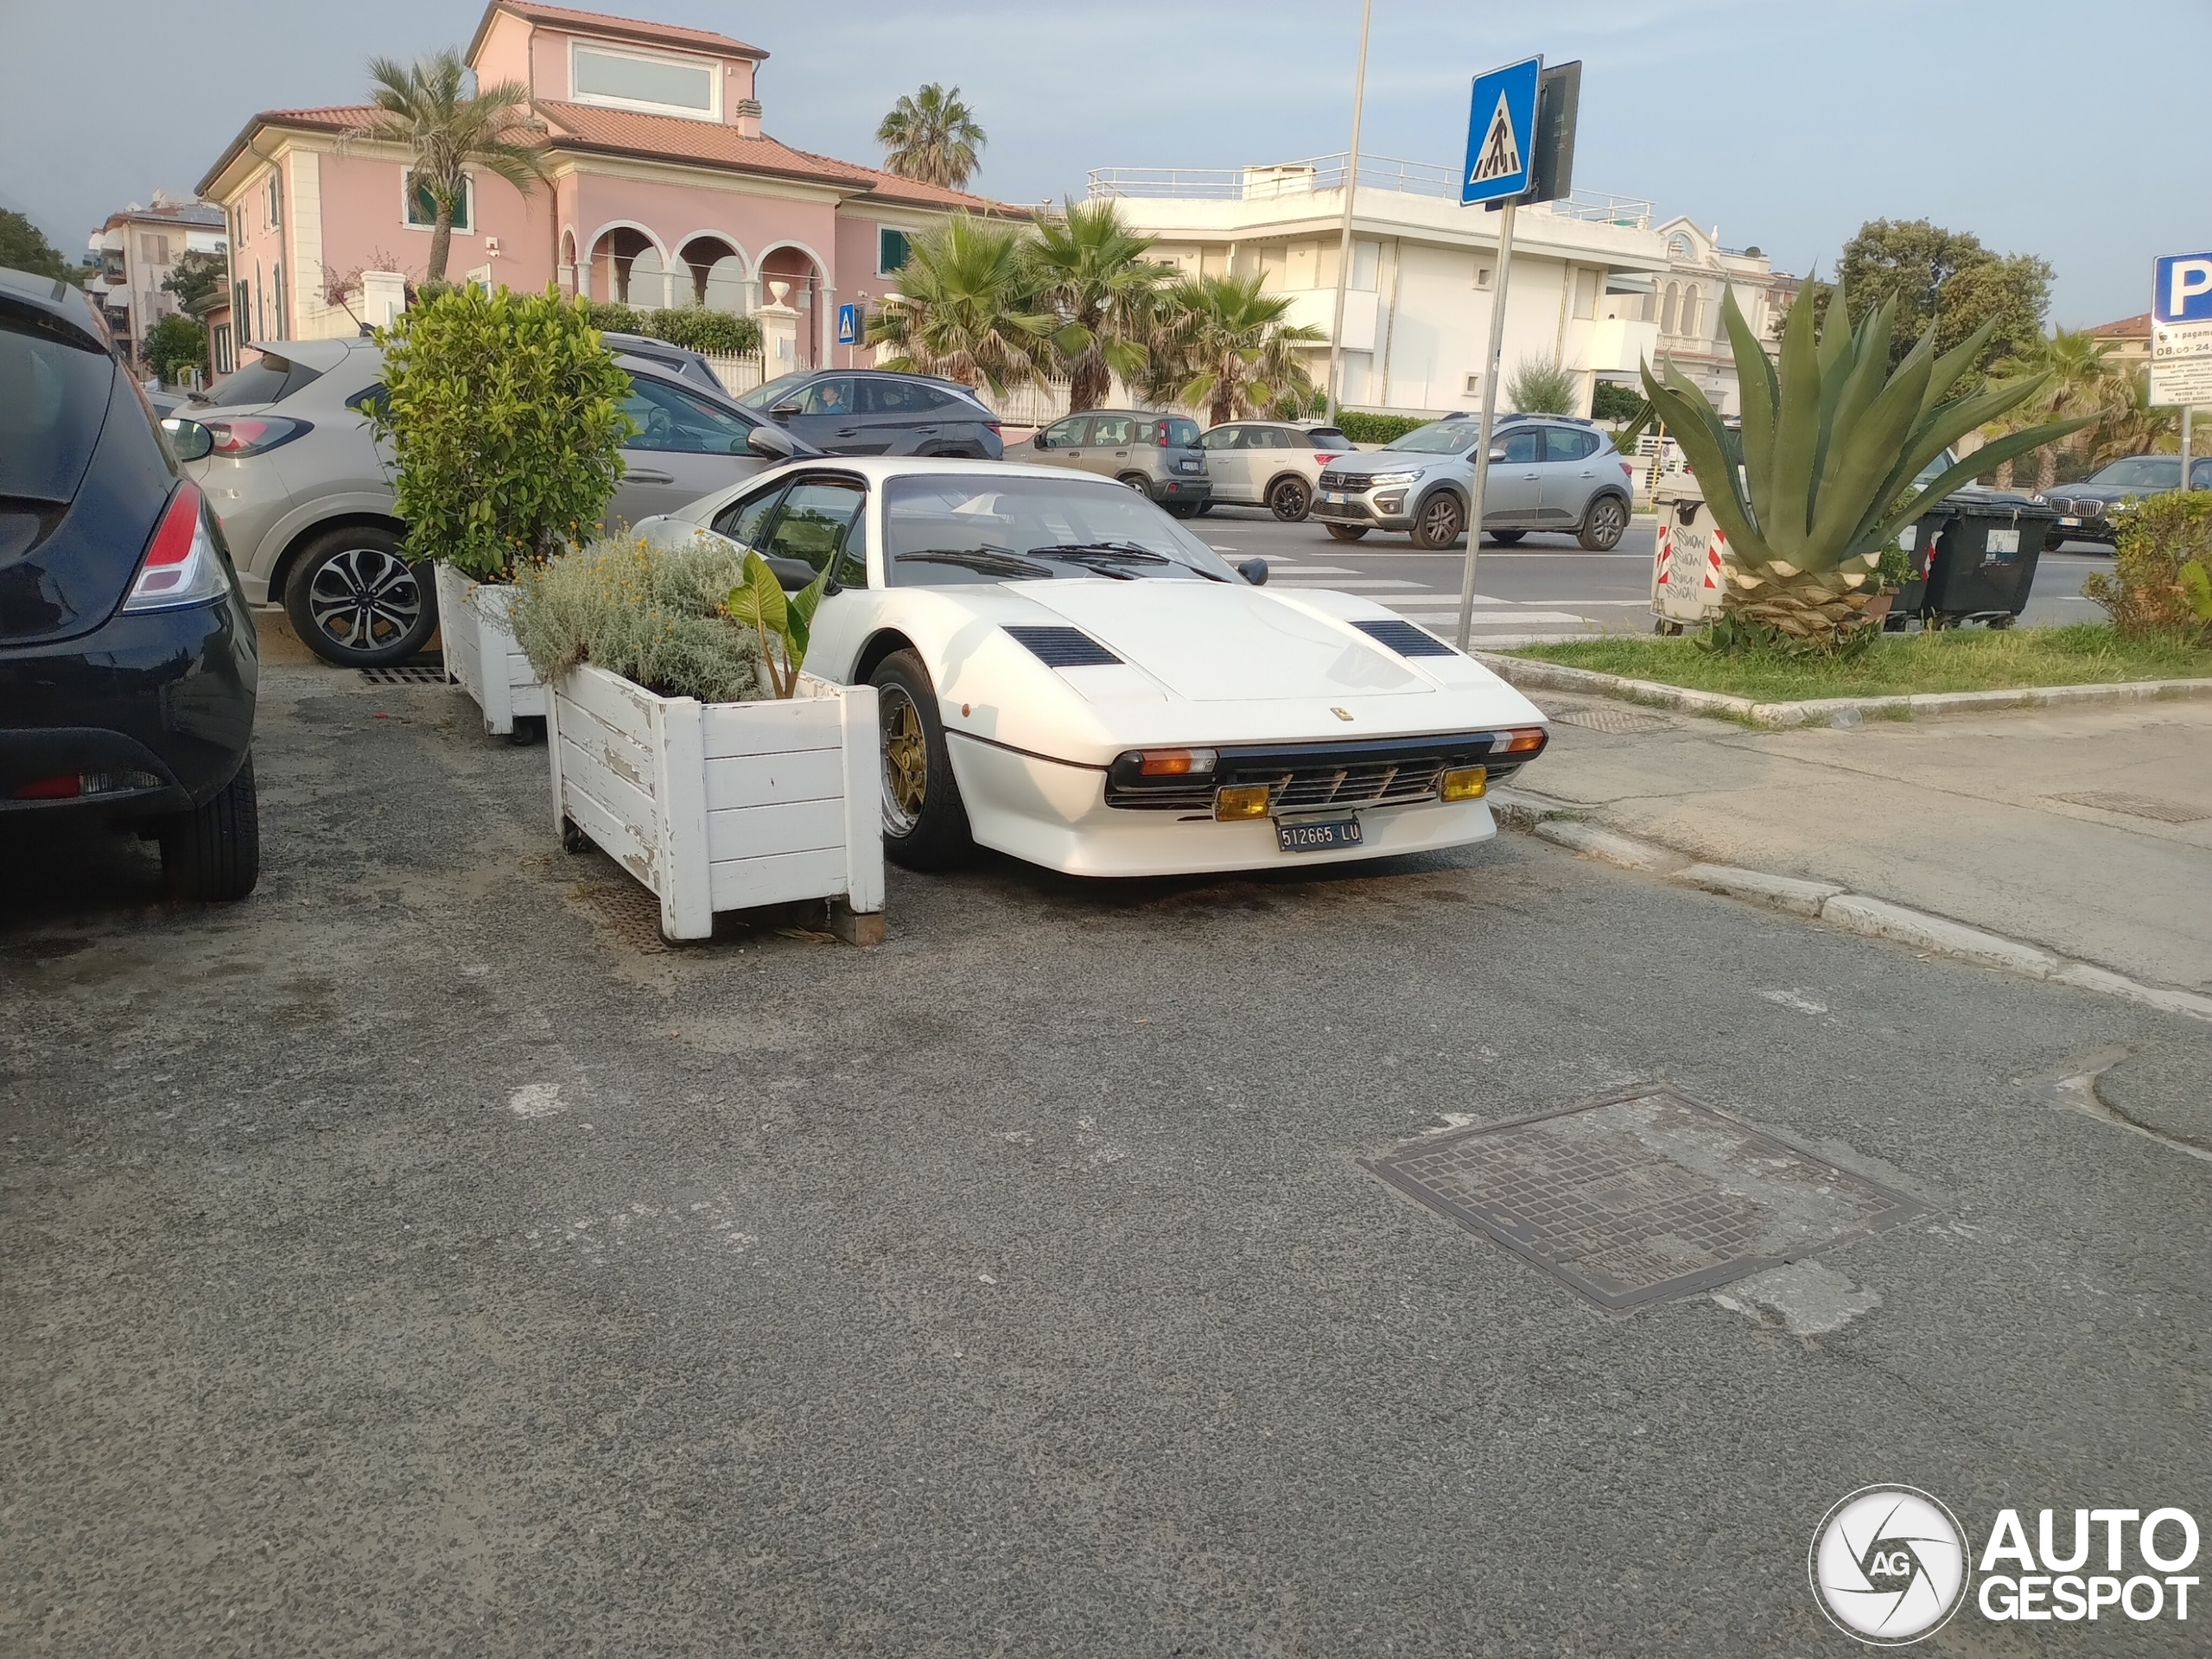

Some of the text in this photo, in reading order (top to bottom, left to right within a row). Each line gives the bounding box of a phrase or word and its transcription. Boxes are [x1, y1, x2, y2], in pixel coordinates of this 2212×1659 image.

[2170, 259, 2212, 316] P
[1281, 824, 1358, 846] 512665 LU
